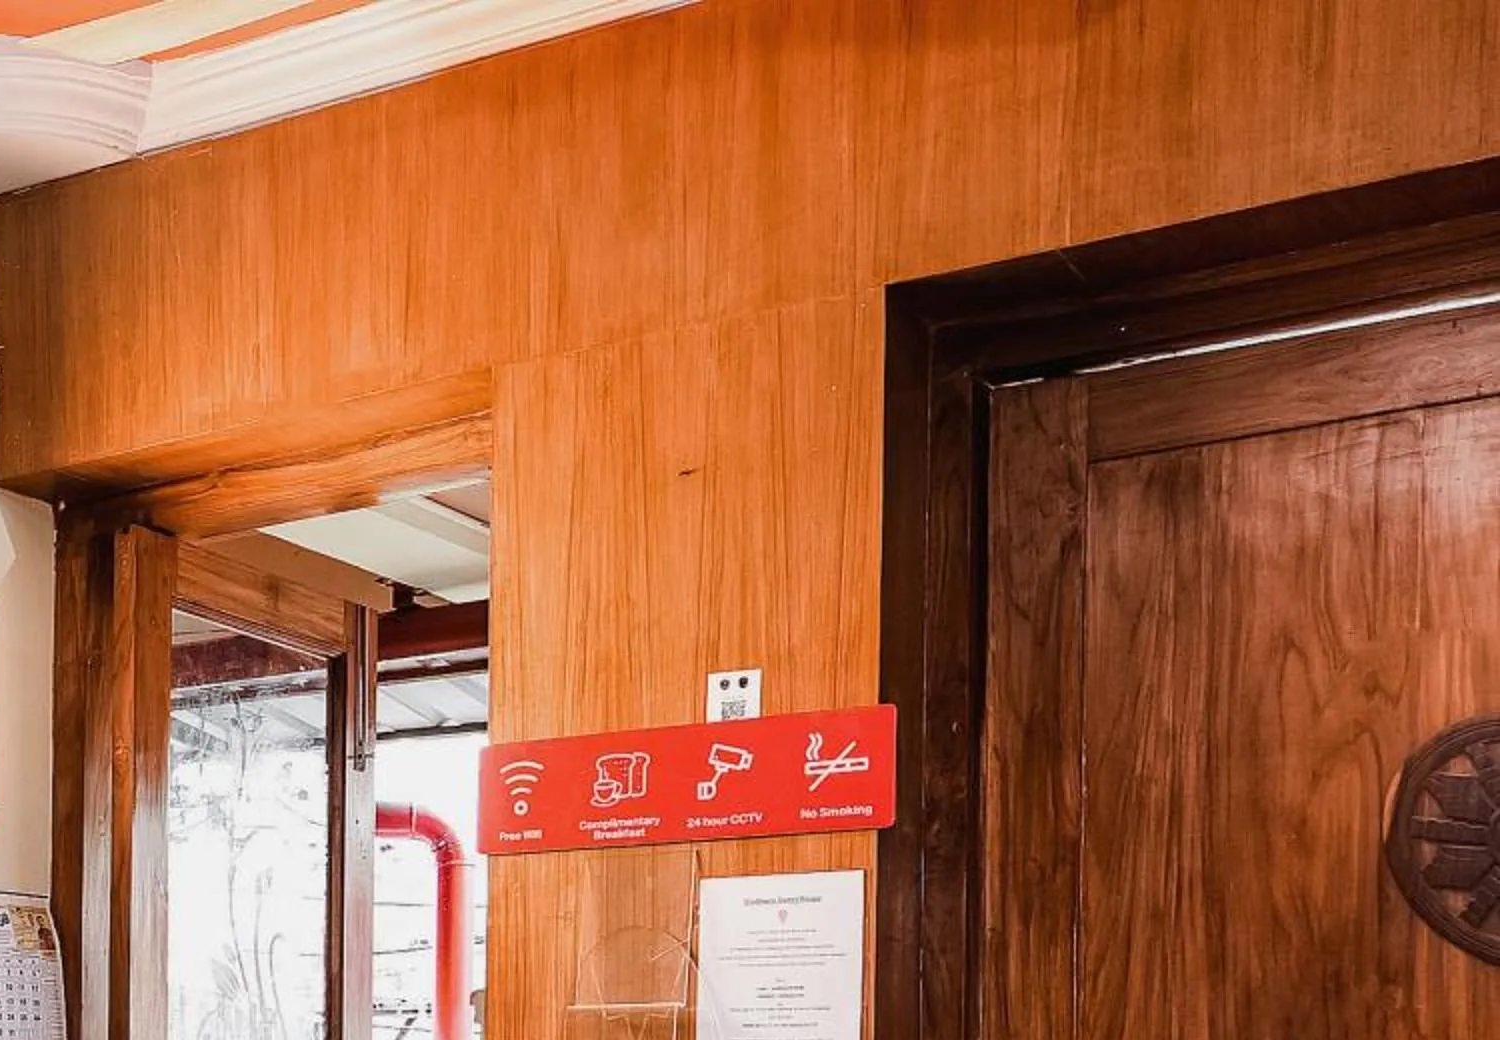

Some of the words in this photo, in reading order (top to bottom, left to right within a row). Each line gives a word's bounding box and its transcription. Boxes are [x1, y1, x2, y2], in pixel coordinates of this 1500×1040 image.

[730, 812, 764, 825] CCTV
[819, 803, 873, 820] Smoking
[579, 817, 661, 832] Complimentary
